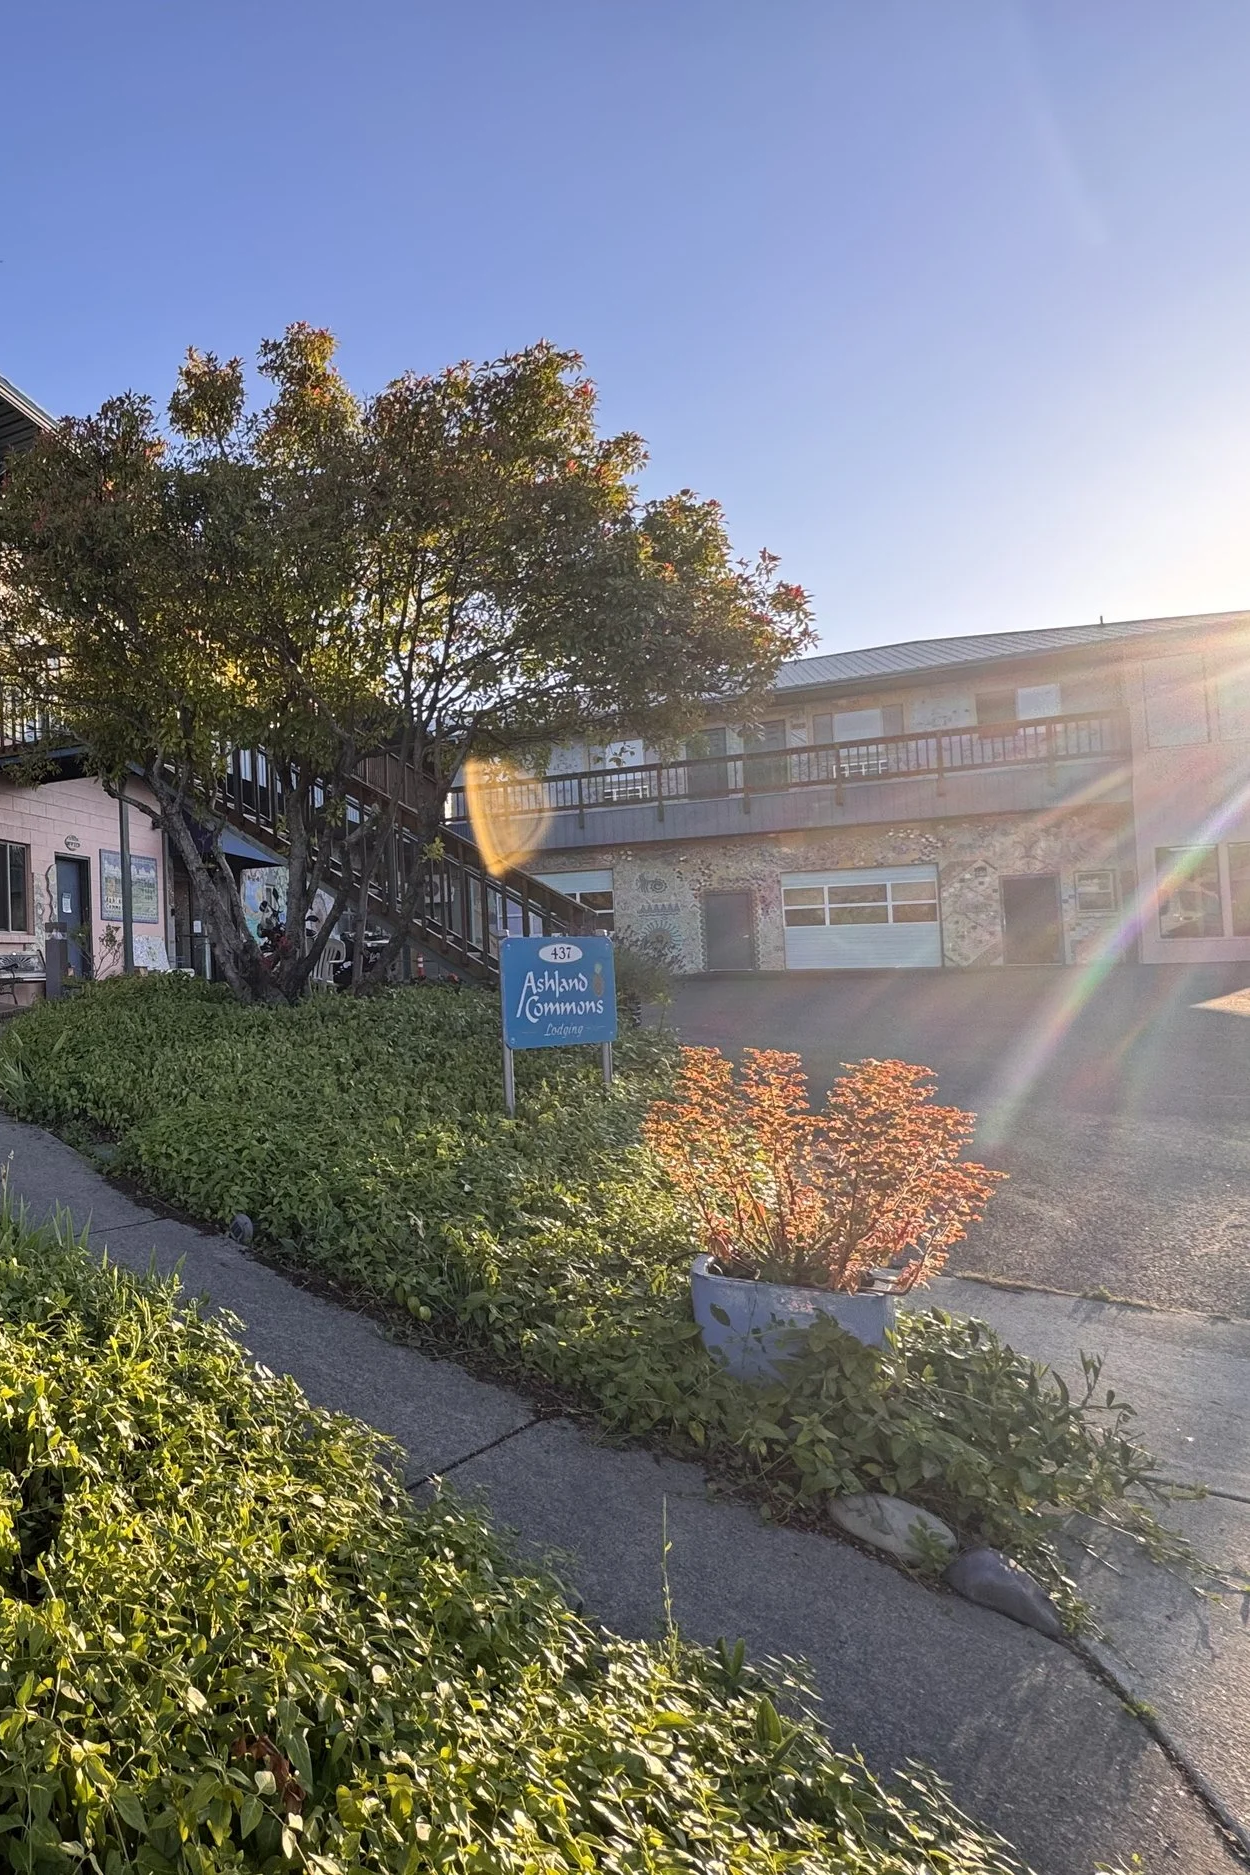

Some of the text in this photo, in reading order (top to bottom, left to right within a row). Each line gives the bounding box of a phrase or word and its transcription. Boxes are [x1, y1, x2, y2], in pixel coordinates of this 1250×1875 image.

[550, 946, 572, 960] 437
[516, 970, 588, 1018] Ashland
[525, 995, 604, 1024] Commons
[544, 1023, 584, 1039] Lodging
